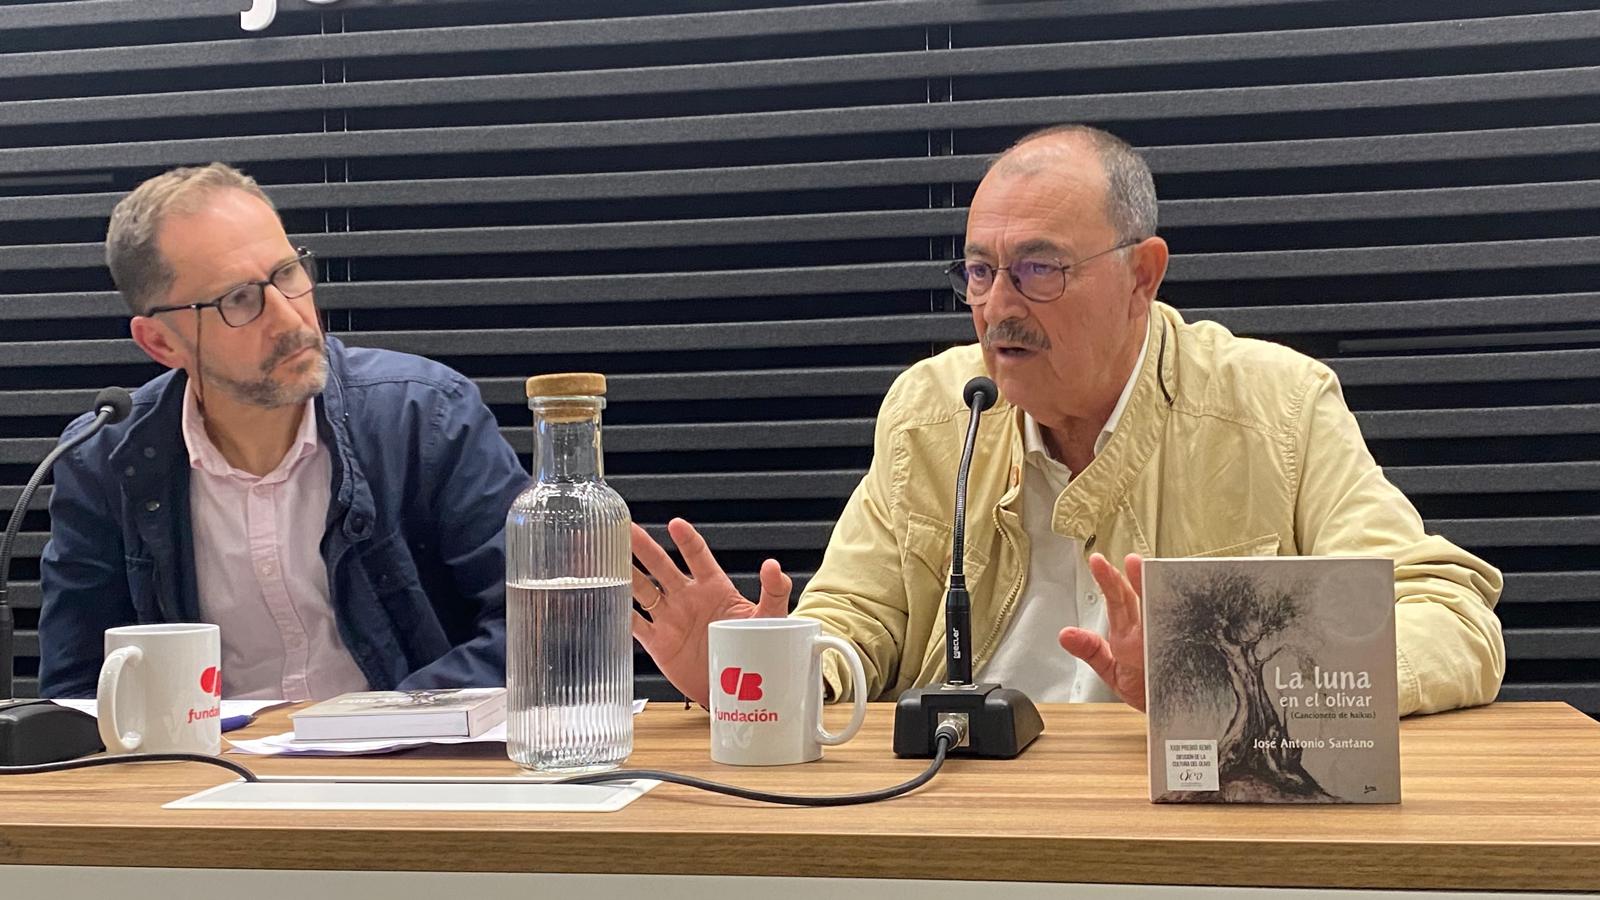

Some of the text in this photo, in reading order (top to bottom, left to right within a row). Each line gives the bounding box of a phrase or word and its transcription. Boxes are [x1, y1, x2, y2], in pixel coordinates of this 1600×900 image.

[1275, 666, 1372, 690] La luna
[1280, 692, 1372, 708] en el olivar
[1338, 711, 1349, 719] de
[1253, 737, 1375, 749] José Antonio Santano
